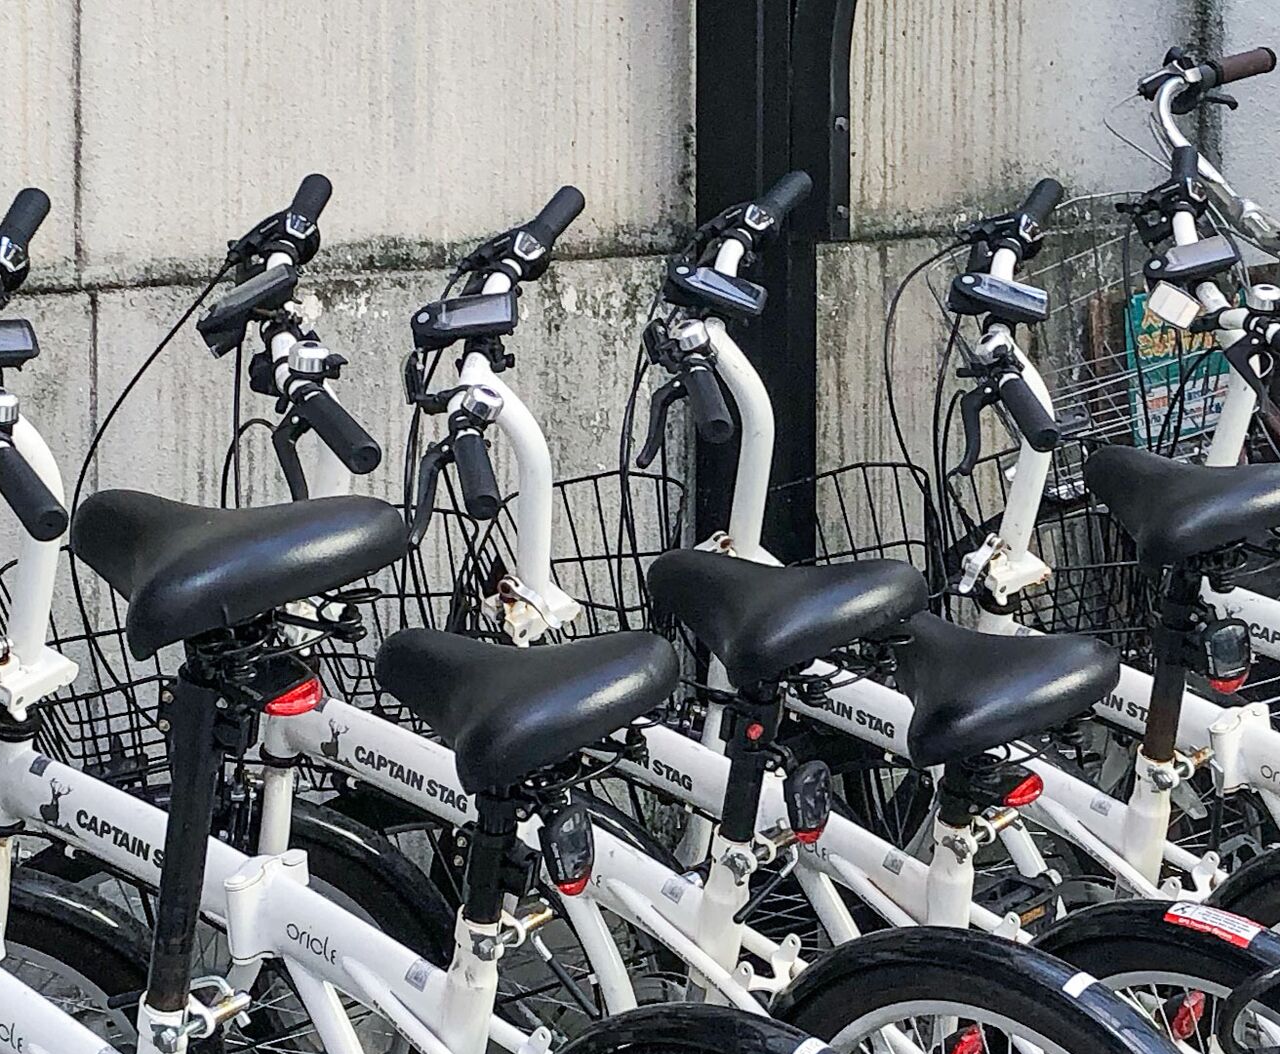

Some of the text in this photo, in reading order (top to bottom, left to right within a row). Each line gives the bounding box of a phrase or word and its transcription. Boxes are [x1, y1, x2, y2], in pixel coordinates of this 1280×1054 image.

[855, 709, 895, 739] STAG
[354, 745, 468, 813] CAPTAIN STAG
[652, 759, 693, 791] STAG
[76, 809, 151, 862] CAPTAIN
